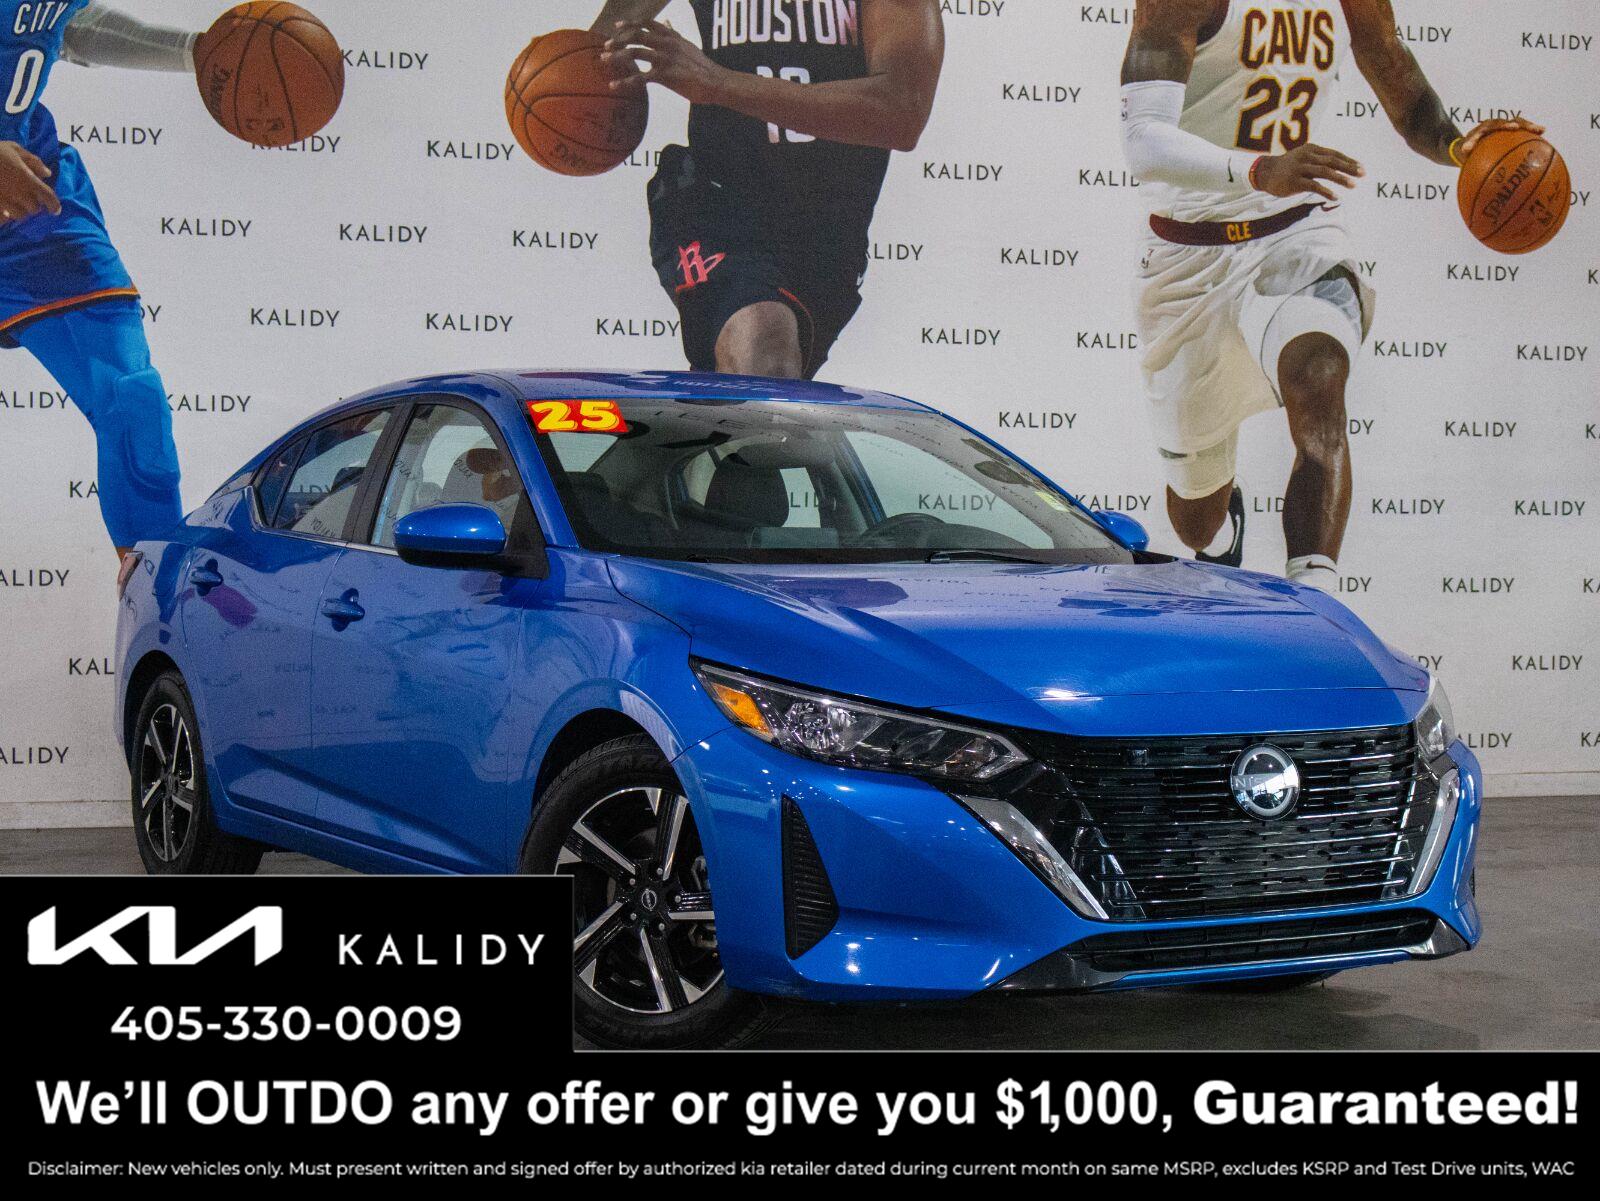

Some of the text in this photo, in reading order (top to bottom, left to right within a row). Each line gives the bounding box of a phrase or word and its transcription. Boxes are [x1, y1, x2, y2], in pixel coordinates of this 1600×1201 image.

[13, 1, 69, 35] CITY
[1081, 6, 1133, 25] KALI
[712, 0, 858, 50] HOUSTON
[1239, 7, 1335, 71] CAVS
[1521, 33, 1593, 50] KALIDY
[5, 49, 45, 114] 0
[1002, 84, 1080, 102] KALIDY
[1234, 75, 1318, 155] 23
[70, 124, 162, 145] KALIDY
[426, 140, 514, 160] KALIDY
[923, 163, 1003, 181] KALIDY
[1376, 183, 1449, 200] KALIDY
[161, 218, 251, 237] KALIDY
[339, 224, 427, 243] KALIDY
[1226, 221, 1252, 243] CLE
[513, 230, 598, 249] KALIDY
[1000, 248, 1078, 266] KALIDY
[1447, 265, 1519, 281] KALIDY
[250, 308, 339, 327] KALIDY
[426, 313, 513, 332] KALIDY
[597, 318, 680, 337] KALIDY
[921, 328, 1000, 345] KALIDY
[1374, 341, 1448, 358] KALIDY
[1516, 345, 1588, 361] KALIDY
[531, 400, 620, 431] 25
[998, 412, 1077, 428] KALIDY
[1444, 422, 1517, 438] KALIDY
[919, 494, 996, 510] KALIDY
[1372, 498, 1445, 514] KALIDY
[1514, 500, 1586, 516] KALIDY
[1442, 578, 1515, 593] KALIDY
[1512, 655, 1583, 670] KALIDY
